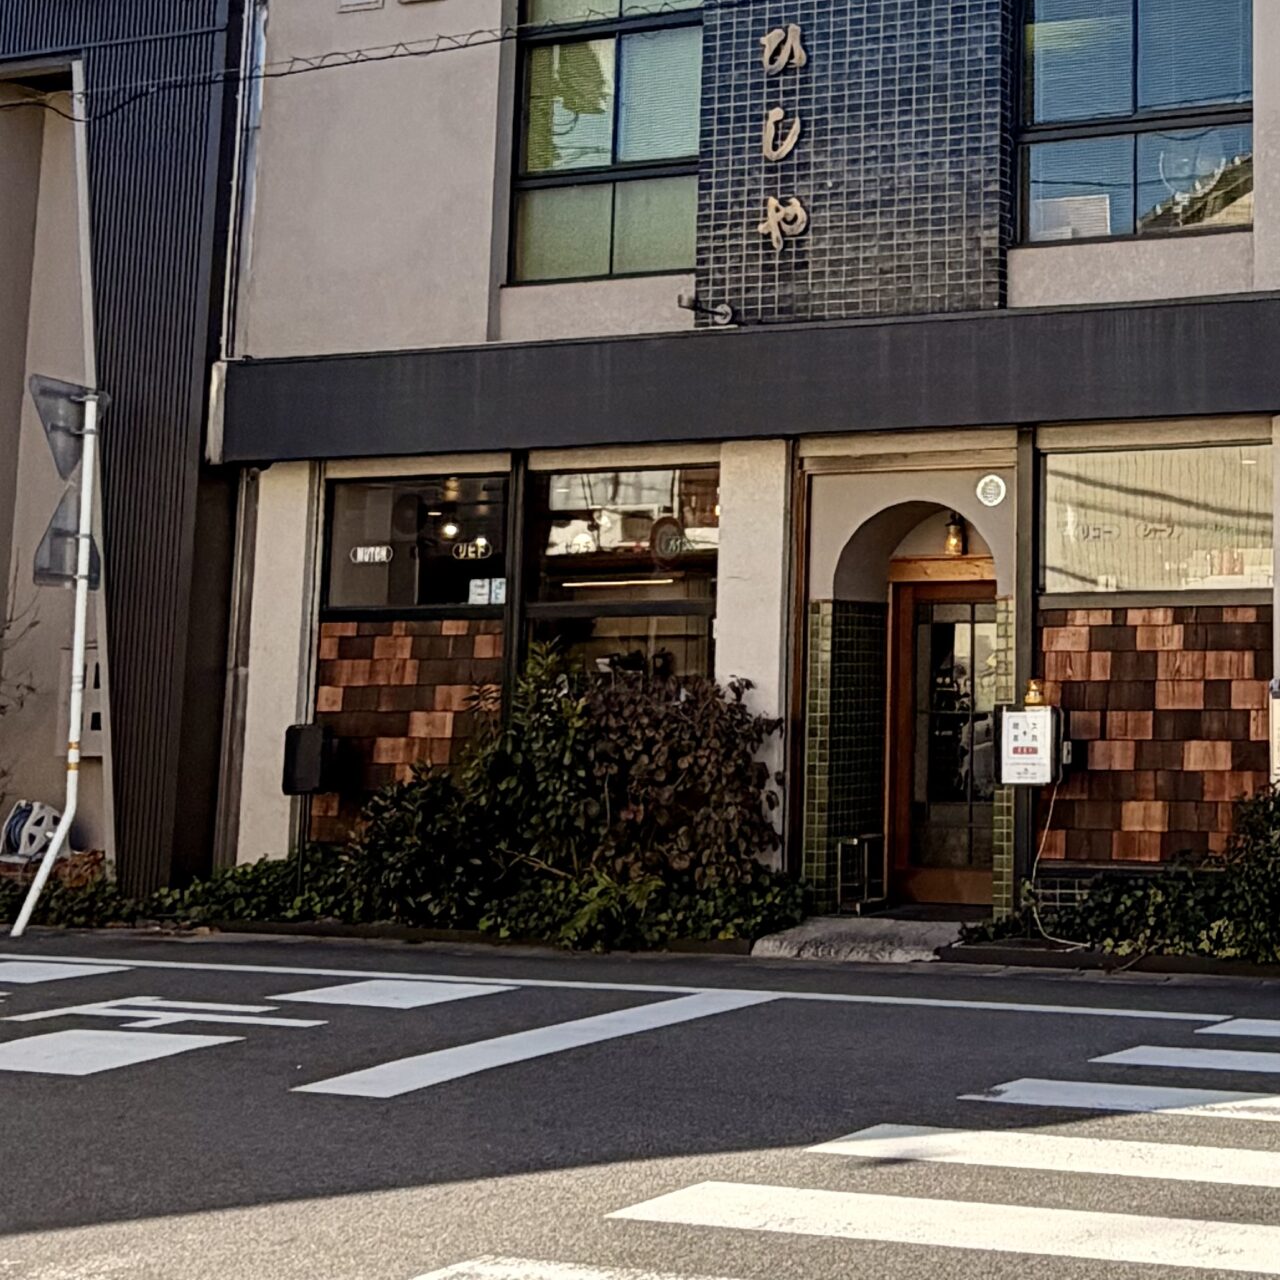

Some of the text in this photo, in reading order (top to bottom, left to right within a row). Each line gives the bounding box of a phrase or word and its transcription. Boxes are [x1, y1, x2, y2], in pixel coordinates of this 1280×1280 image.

[757, 23, 807, 252] ひしや
[1081, 524, 1113, 540] リコー
